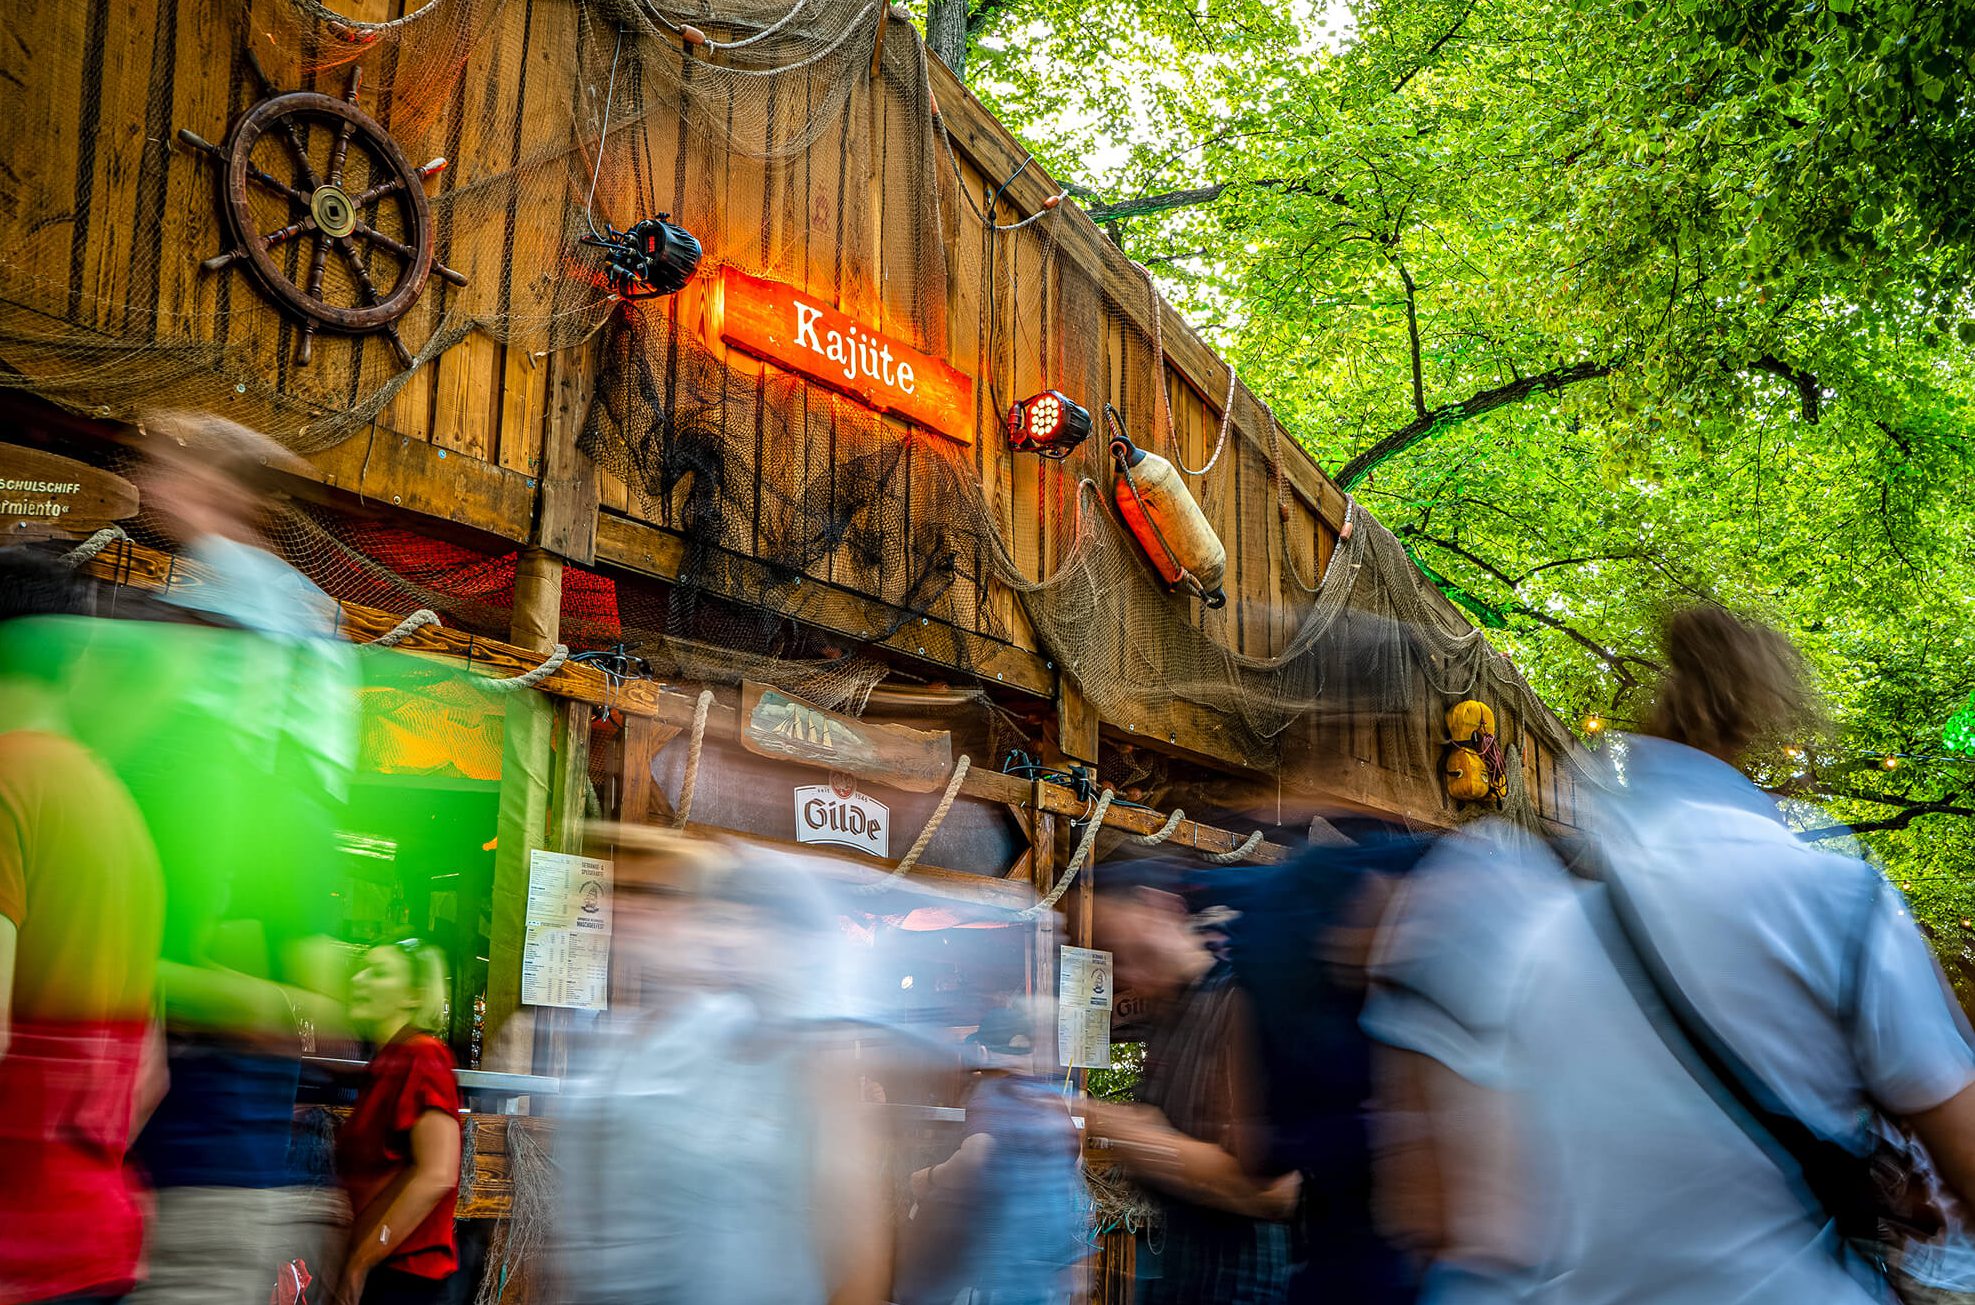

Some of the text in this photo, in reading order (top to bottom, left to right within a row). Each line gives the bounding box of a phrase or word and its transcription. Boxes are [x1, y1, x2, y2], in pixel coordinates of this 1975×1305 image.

[793, 300, 915, 395] Kajüte
[0, 479, 80, 493] SCHULSCHIFF
[0, 499, 69, 516] rmiento«
[804, 798, 881, 841] Gilde
